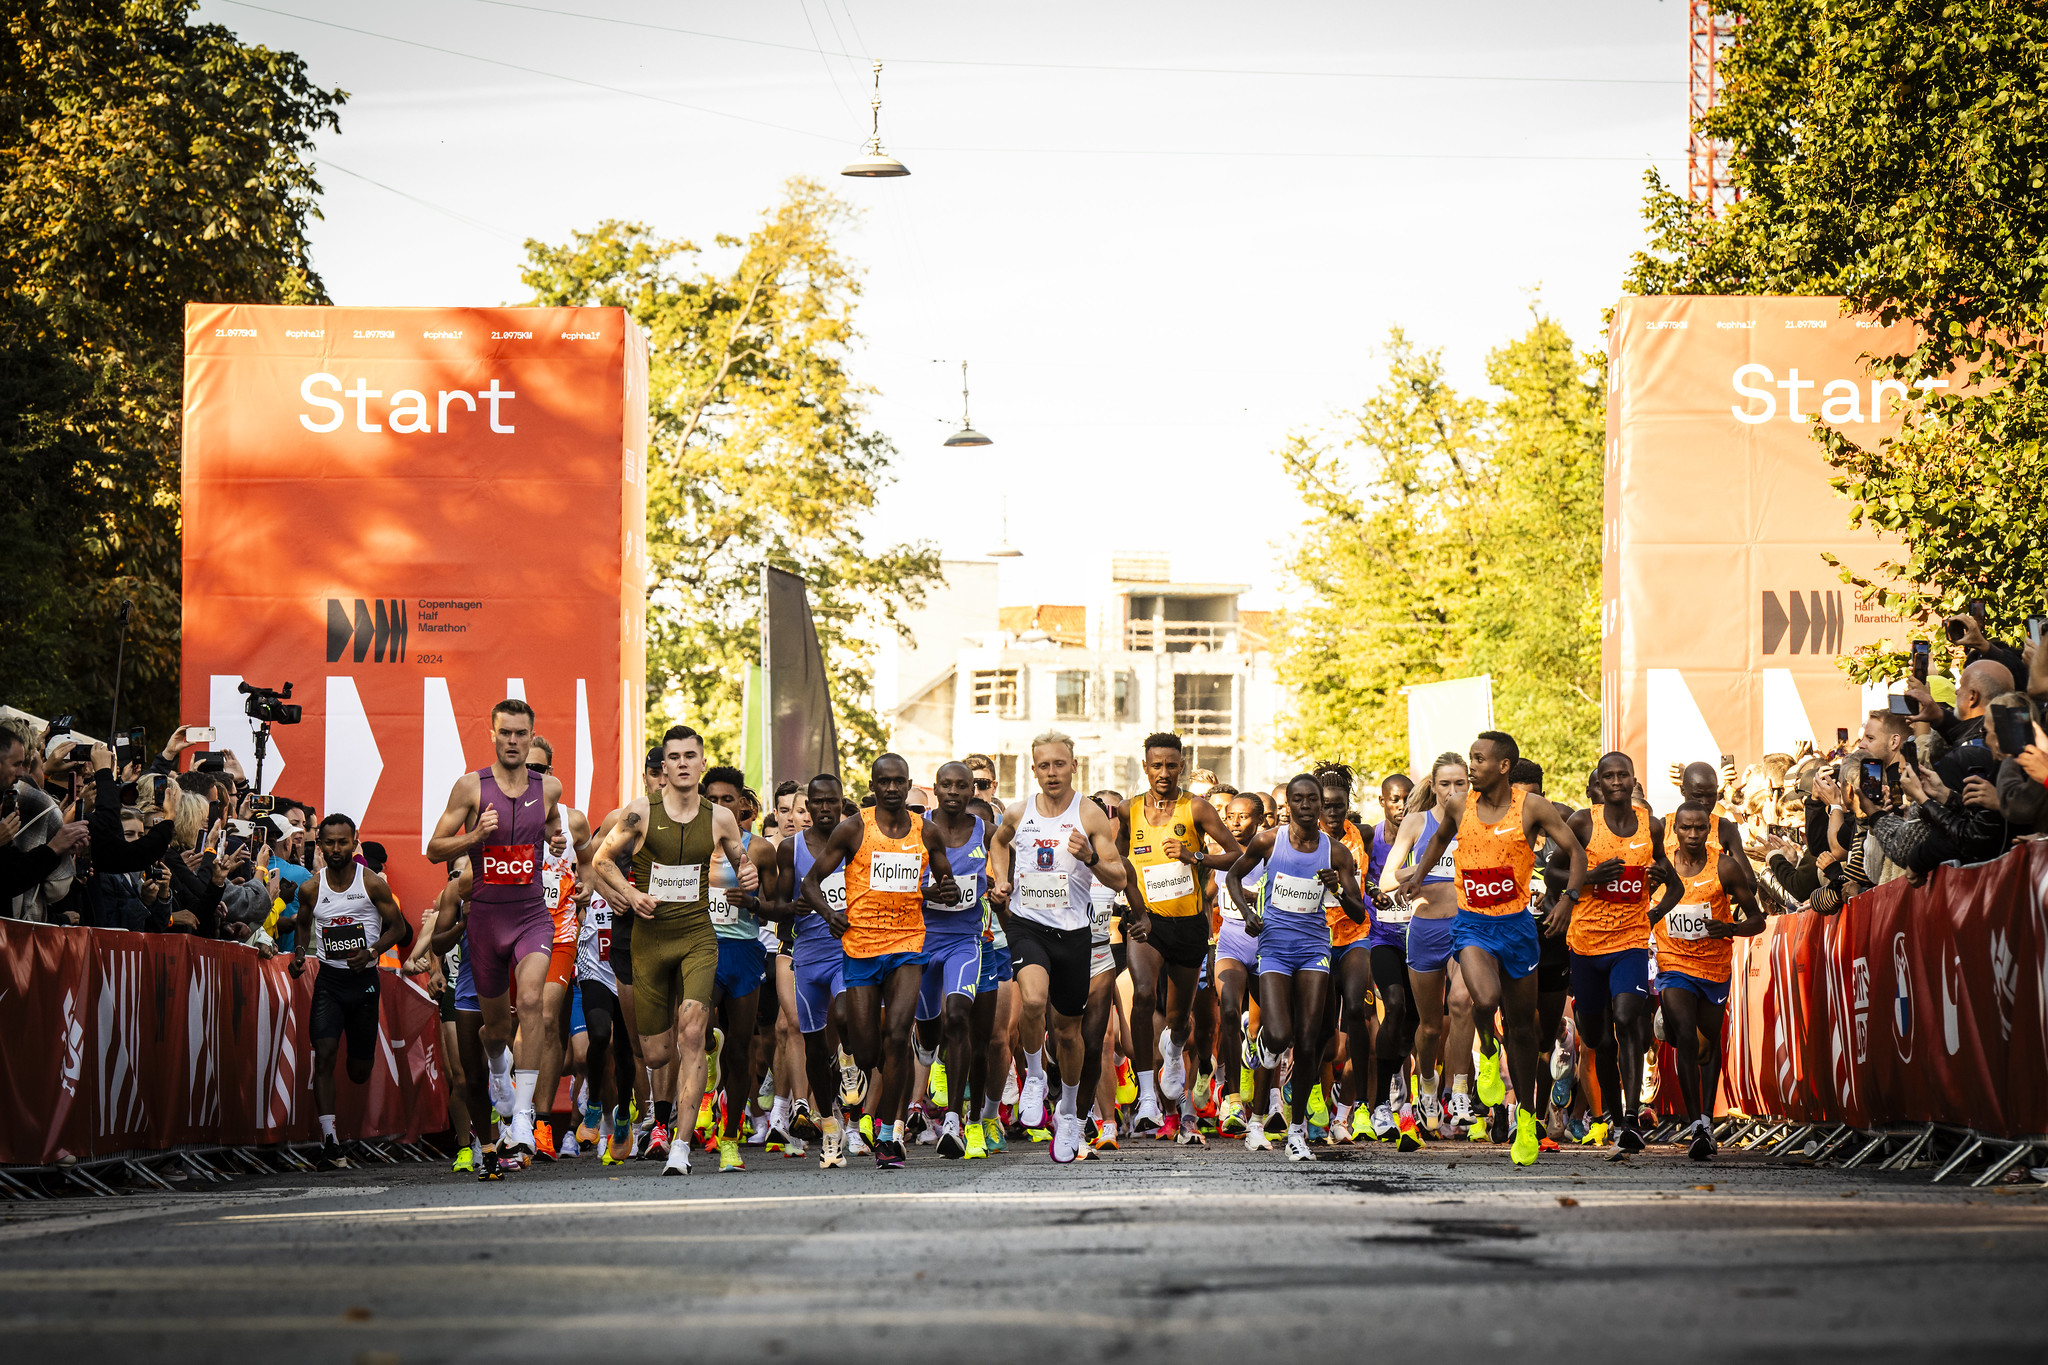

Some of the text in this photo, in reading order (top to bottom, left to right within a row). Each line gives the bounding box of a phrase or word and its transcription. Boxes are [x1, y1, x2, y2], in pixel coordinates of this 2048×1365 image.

[1646, 319, 1896, 331] 21.0975KM #cphhalf 21.0975KM #cphhf
[215, 329, 601, 341] 21.0975KM #cphhalf 21.0975KM #cphhalf 21.0975KM #cphhalf
[299, 372, 516, 434] Start
[418, 599, 483, 611] Copenhagen
[1854, 602, 1875, 611] Half
[418, 611, 438, 620] Half
[1854, 613, 1903, 623] Marathon
[418, 622, 467, 632] Marathon
[416, 654, 443, 664] 2024
[483, 856, 534, 875] Pace
[873, 862, 919, 882] Kiplimo
[651, 874, 698, 889] Ingebrigtsen
[1146, 874, 1192, 890] Fissehatsion
[1463, 878, 1514, 897] Pace
[1594, 879, 1642, 894] ace
[1021, 885, 1067, 898] Simonsen
[1274, 883, 1322, 900] Kipkemboi
[708, 897, 731, 917] dey
[323, 936, 366, 952] Hassan
